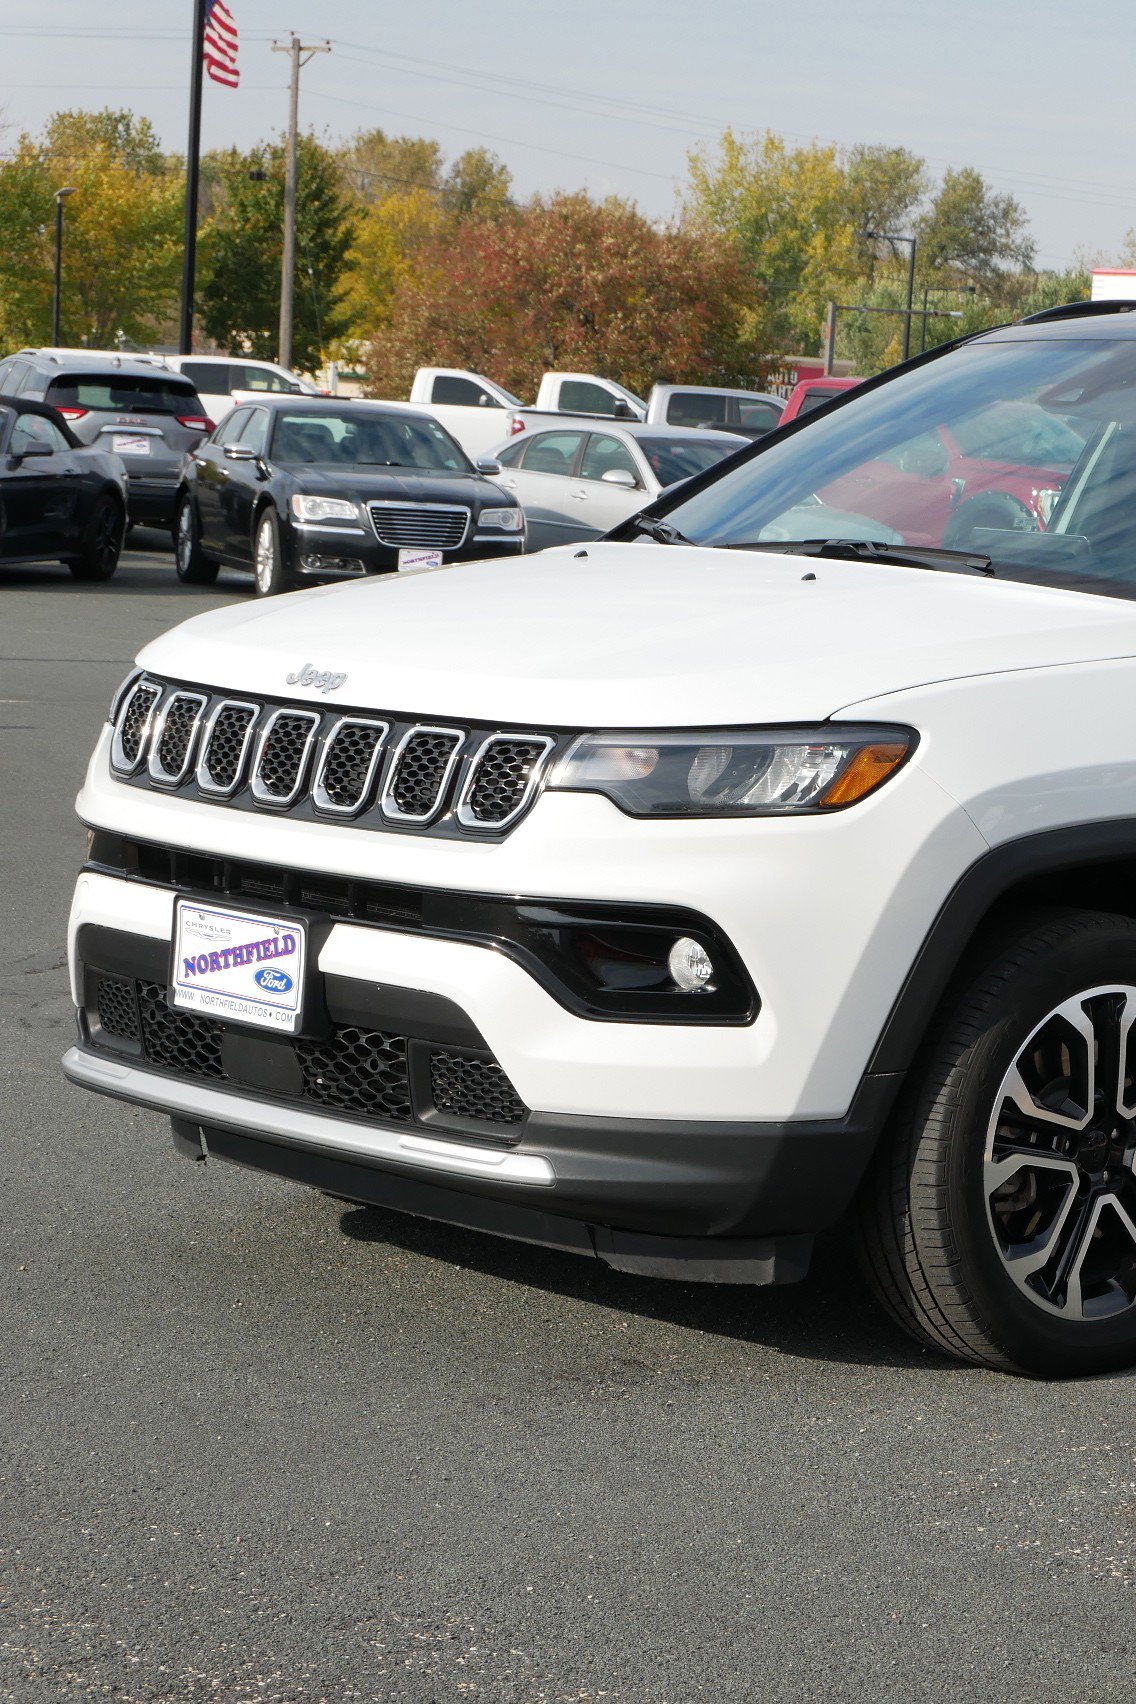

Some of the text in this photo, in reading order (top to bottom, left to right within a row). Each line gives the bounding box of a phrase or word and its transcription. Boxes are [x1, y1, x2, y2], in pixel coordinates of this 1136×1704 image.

[286, 662, 348, 695] Jeep
[186, 920, 232, 935] CHRYSLER
[183, 934, 297, 978] NORTHFIELD
[260, 969, 287, 990] Ford
